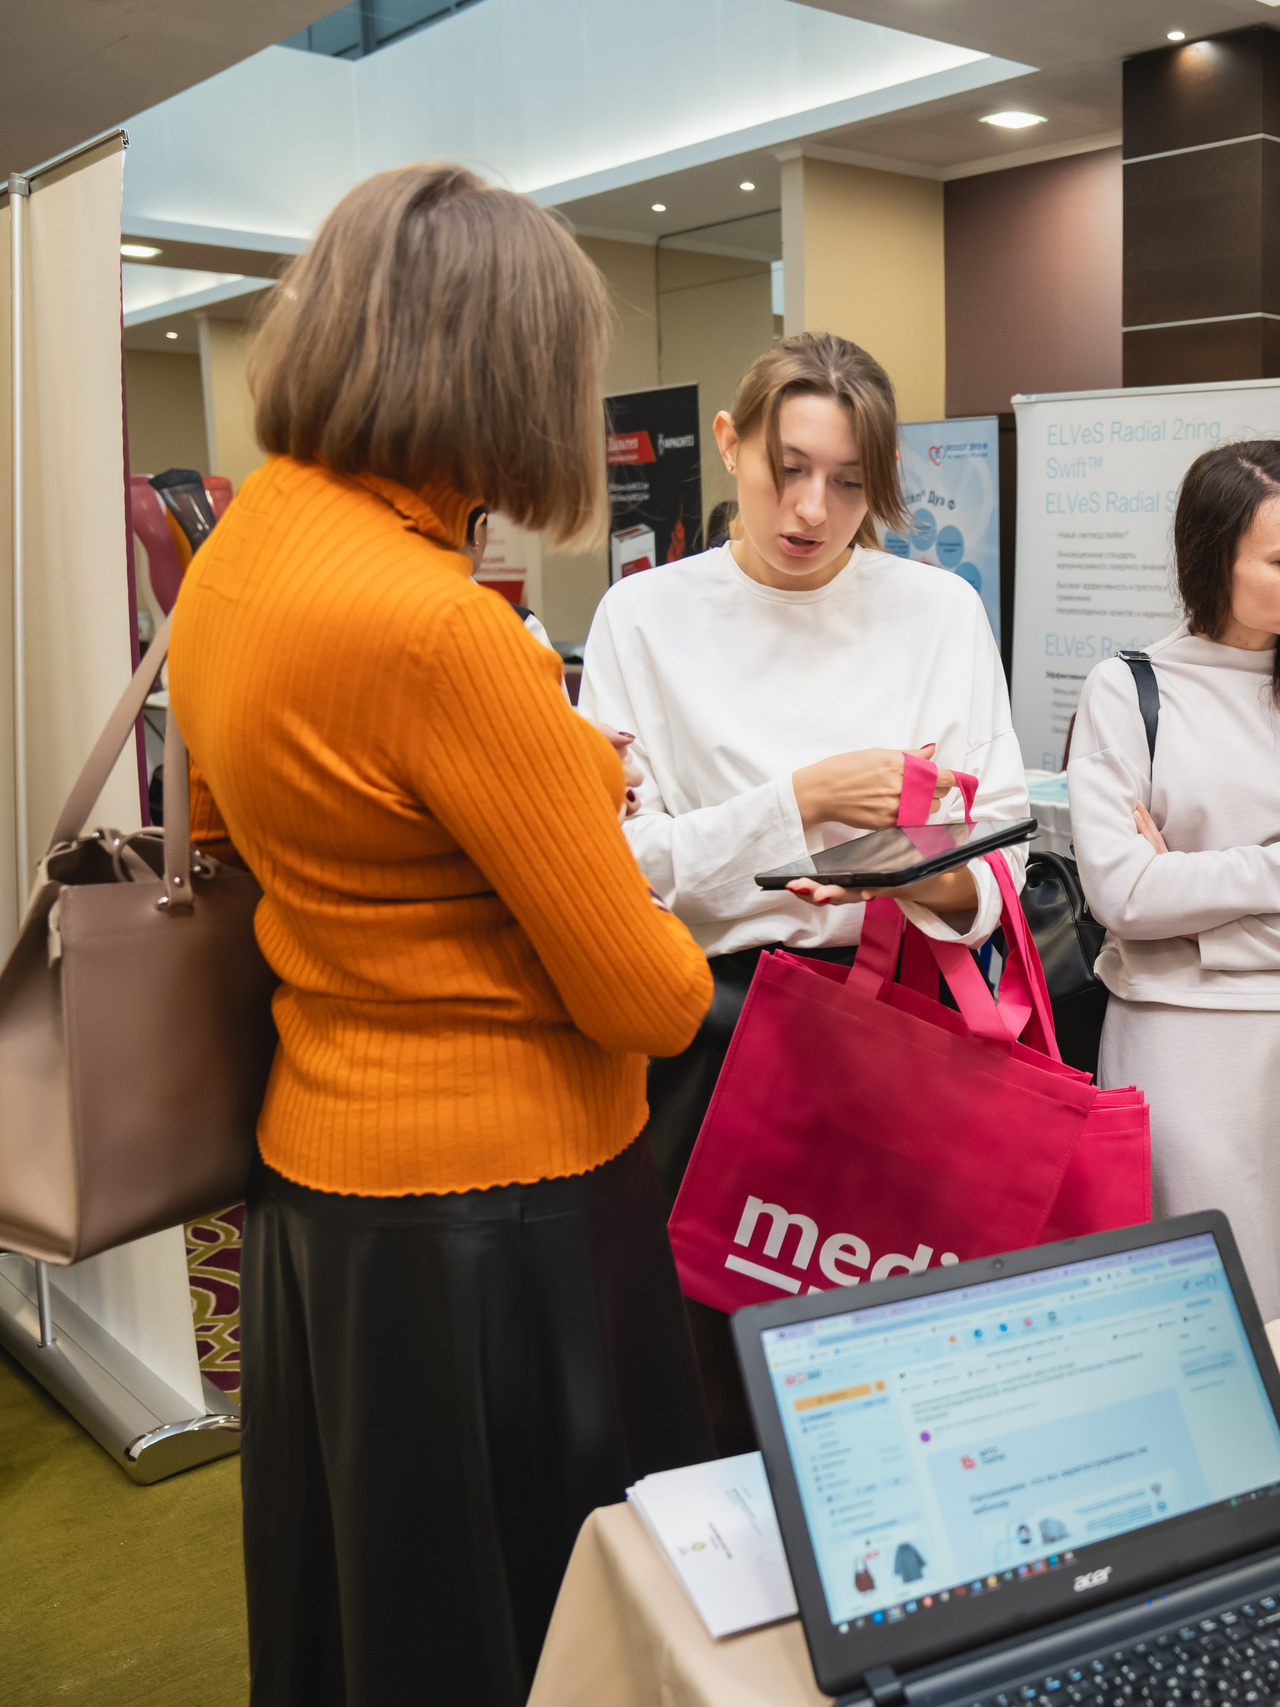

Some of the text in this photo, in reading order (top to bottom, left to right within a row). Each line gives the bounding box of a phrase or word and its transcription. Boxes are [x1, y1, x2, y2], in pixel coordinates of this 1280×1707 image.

[1047, 417, 1221, 447] ELVeS Radial 2ring
[1045, 491, 1101, 514] ELVeS
[1106, 490, 1160, 513] Radial
[1045, 633, 1096, 659] ELVeS
[1073, 1566, 1112, 1592] acer
